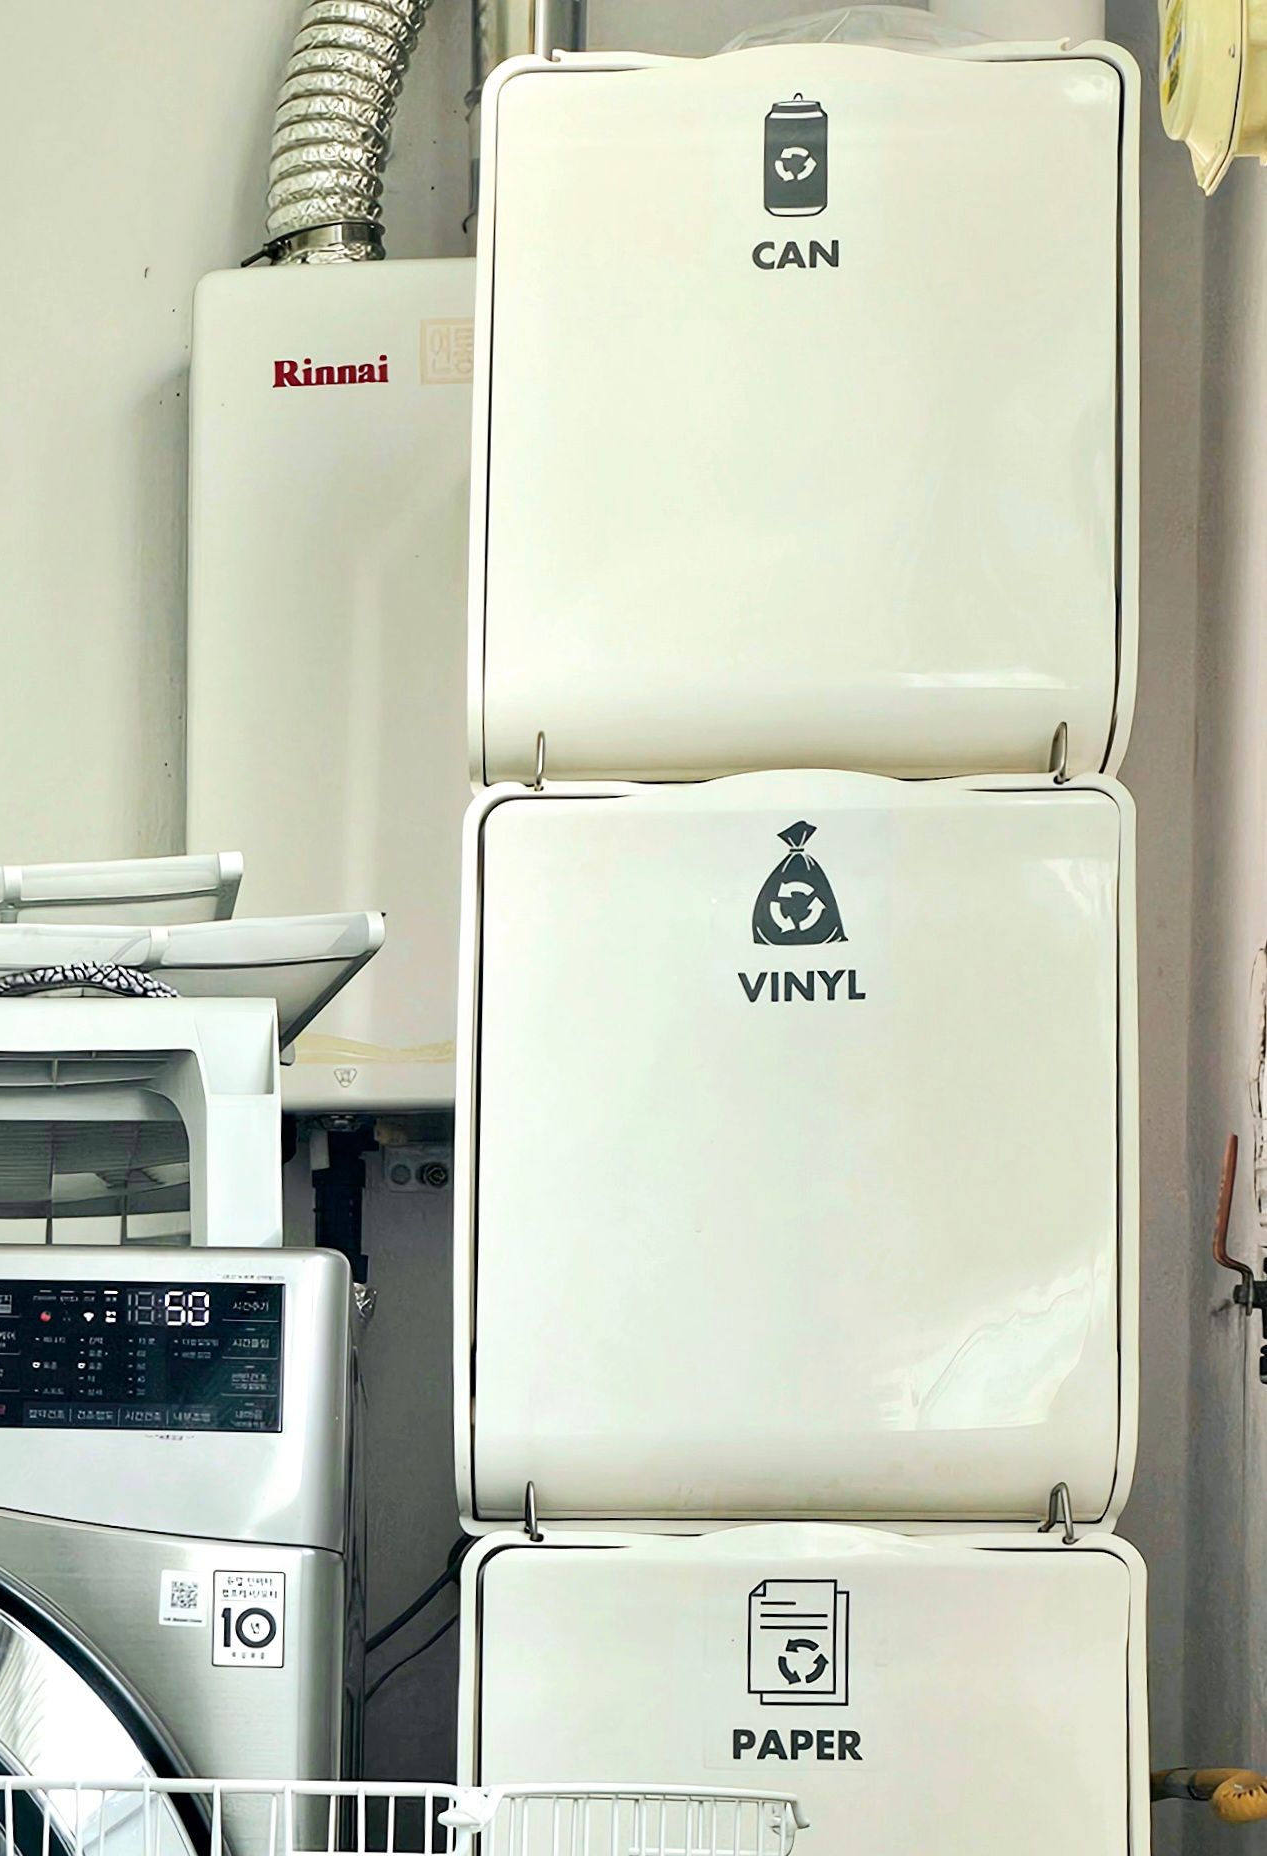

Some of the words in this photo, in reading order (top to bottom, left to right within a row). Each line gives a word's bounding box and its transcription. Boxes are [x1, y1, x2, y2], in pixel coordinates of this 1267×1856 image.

[751, 239, 840, 271] CAN
[273, 354, 389, 388] Rinnai
[737, 969, 867, 1003] VINYL
[733, 1729, 863, 1761] PAPER
